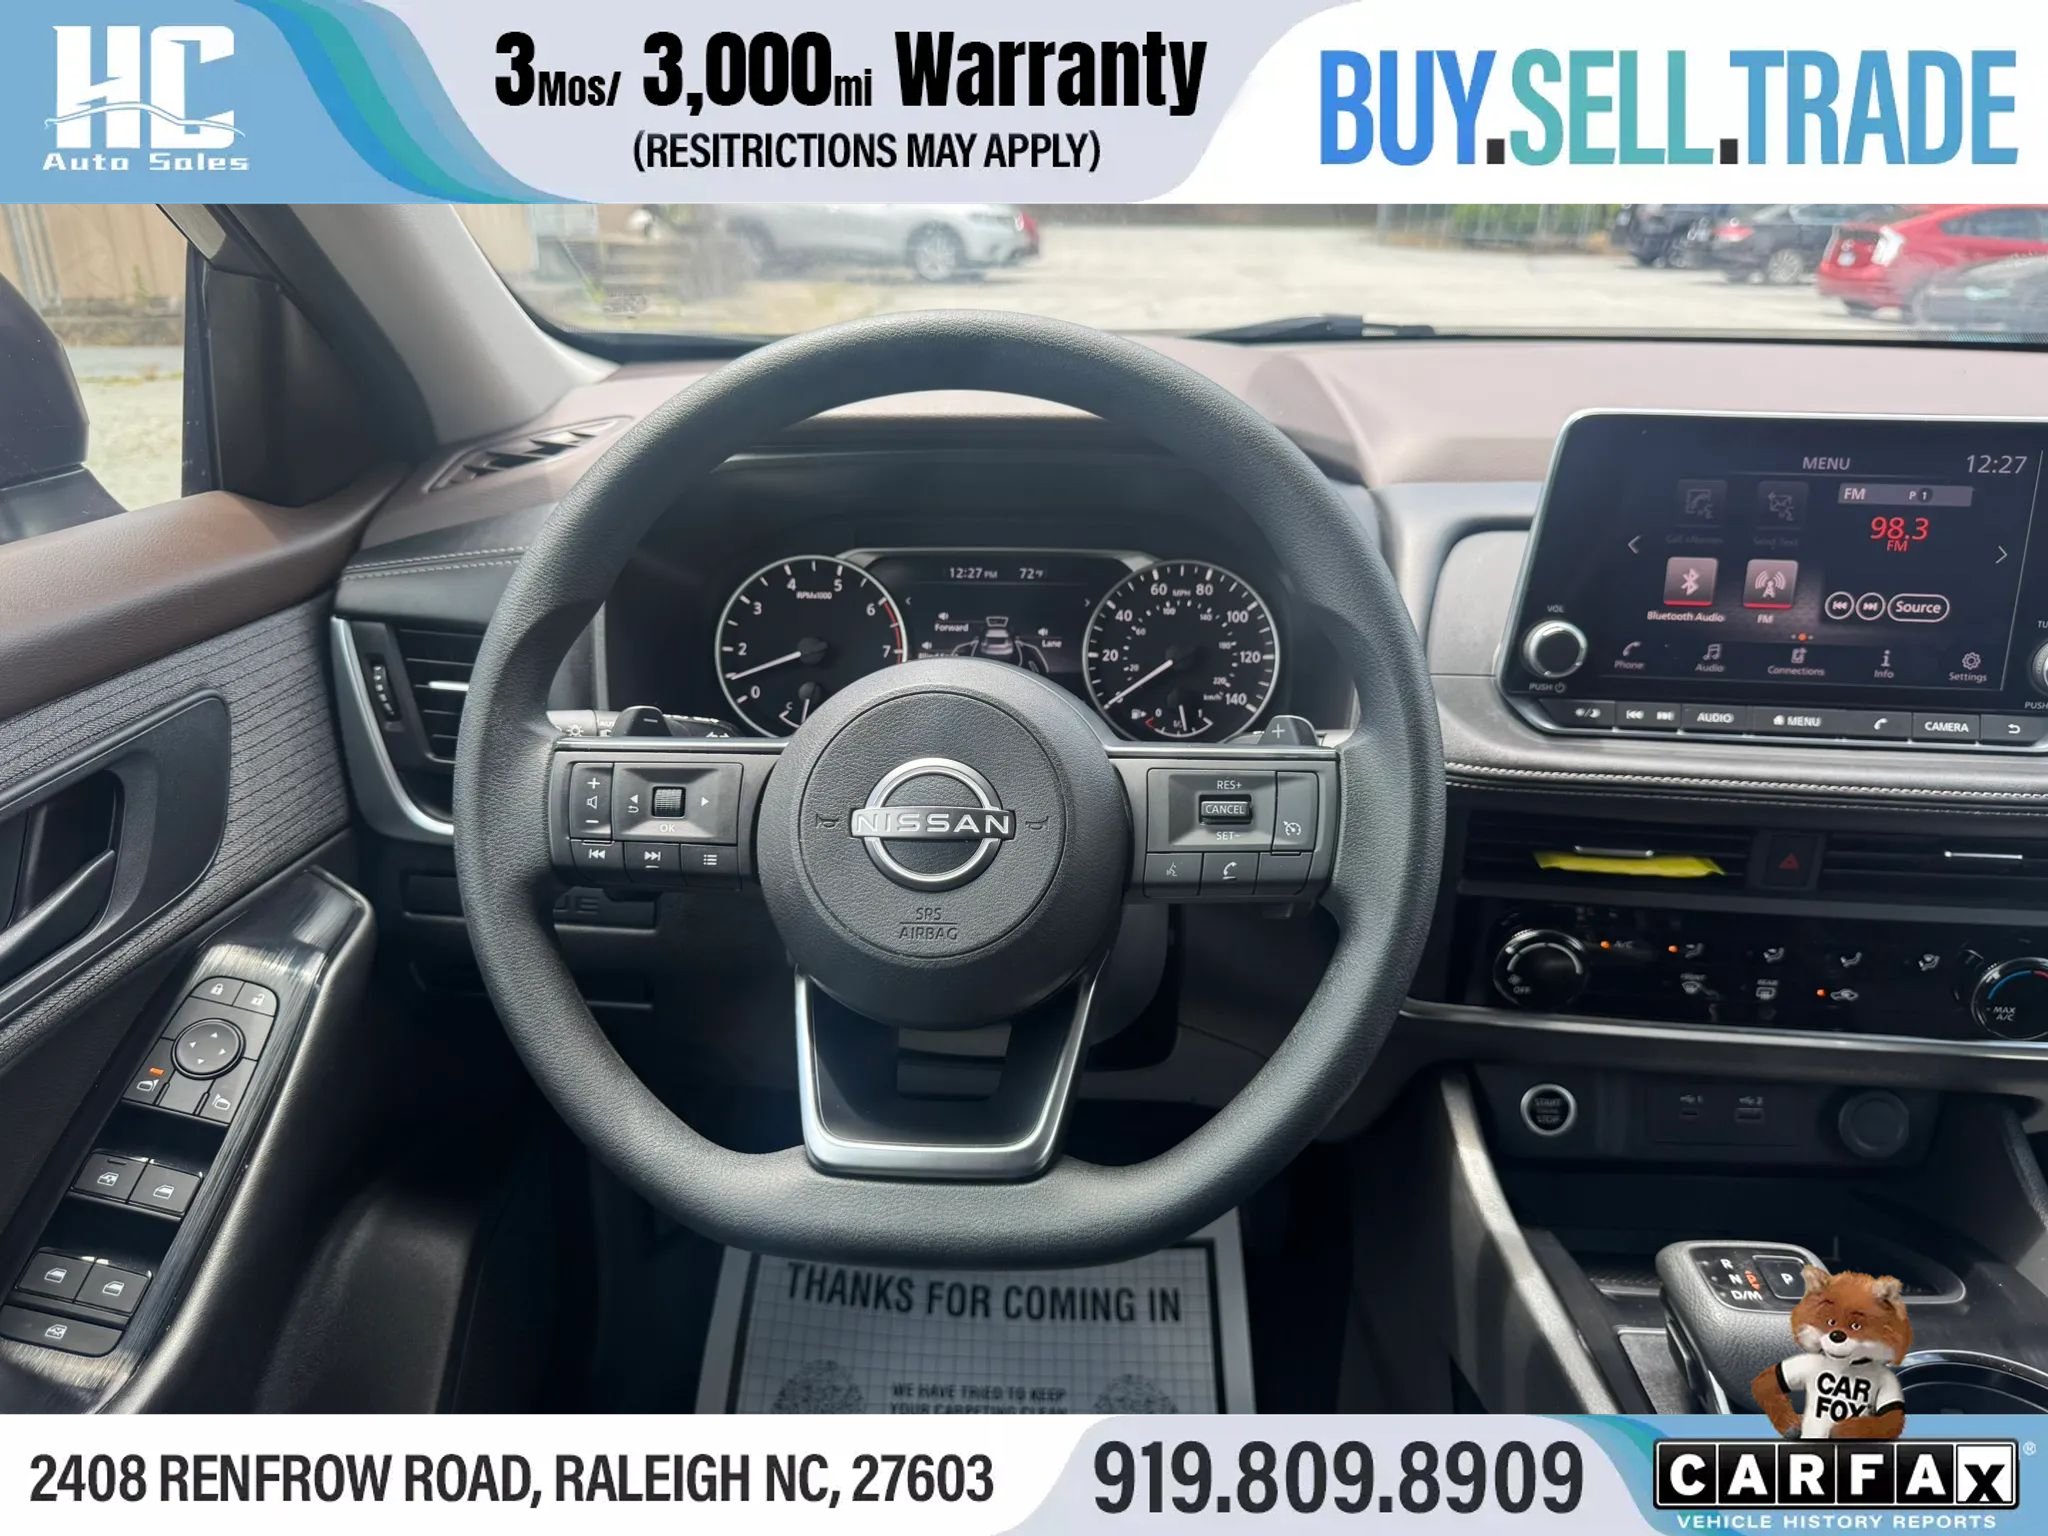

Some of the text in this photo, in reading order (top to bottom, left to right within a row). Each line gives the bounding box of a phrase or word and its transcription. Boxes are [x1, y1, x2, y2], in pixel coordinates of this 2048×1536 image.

[1802, 457, 1850, 470] MENU
[1966, 454, 2027, 474] 12:27
[1844, 488, 1927, 500] FM P 1
[1870, 516, 1929, 540] 98.3
[1887, 540, 1908, 551] FM
[950, 567, 983, 579] 12:27
[787, 578, 797, 590] 4
[834, 579, 843, 592] 5
[1150, 584, 1167, 596] 60
[1172, 589, 1191, 597] MPH
[1196, 584, 1213, 596] 80
[753, 602, 762, 615] 3
[866, 603, 876, 616] 6
[1163, 607, 1176, 615] 100
[1895, 600, 1942, 614] Source
[1115, 610, 1133, 622] 40
[1227, 611, 1249, 623] 100
[1647, 611, 1725, 622] Bluetooth Audio
[1757, 614, 1774, 623] FM
[934, 623, 969, 632] Forward
[738, 643, 747, 656] 2
[1042, 640, 1062, 648] Lane
[882, 645, 891, 658] 7
[1102, 650, 1119, 661] 20
[1240, 651, 1261, 663] 120
[1614, 661, 1644, 669] Phone
[1695, 664, 1724, 673] Audio
[1768, 665, 1825, 676] Connections
[1874, 669, 1894, 679] Info
[1949, 671, 1987, 682] Settings
[751, 686, 761, 698] 0
[1529, 683, 1552, 691] PUSH
[1226, 693, 1247, 705] 140
[785, 702, 793, 710] C
[2024, 701, 2048, 710] PUSH
[1155, 709, 1162, 717] 0
[1198, 709, 1203, 717] 1
[1697, 712, 1734, 723] AUDIO
[1787, 716, 1821, 727] MENU
[1925, 721, 1969, 732] CAMERA
[1217, 780, 1242, 789] RES+
[1206, 805, 1245, 815] CANCEL
[660, 824, 675, 833] OK
[856, 813, 1009, 834] NISSAN
[916, 908, 941, 920] SRS
[899, 927, 958, 940] AIRBAG
[1720, 1259, 1733, 1270] R
[1728, 1274, 1743, 1285] N
[1780, 1273, 1793, 1285] P
[788, 1262, 1182, 1322] THANKS FOR COMING IN
[1731, 1290, 1763, 1301] D/M
[893, 1383, 1067, 1400] WE HAVE TRIED TO KEEP
